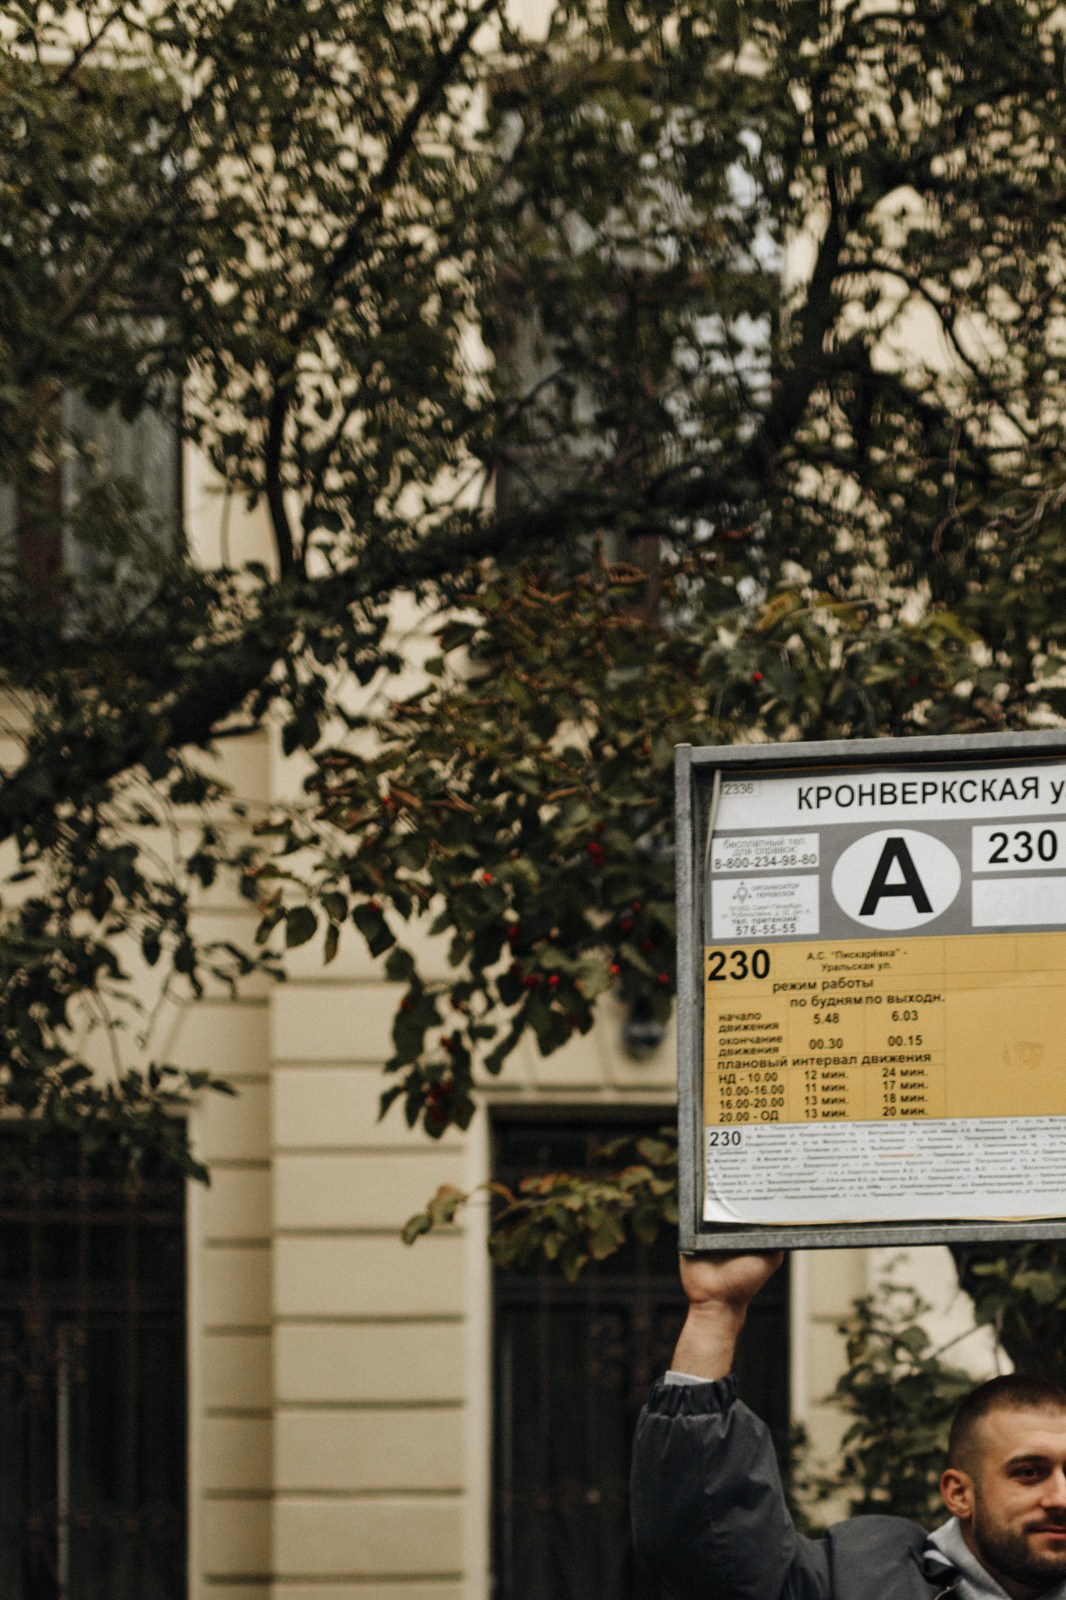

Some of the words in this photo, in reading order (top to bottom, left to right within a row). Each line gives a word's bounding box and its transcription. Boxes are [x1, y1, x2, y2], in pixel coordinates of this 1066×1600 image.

[798, 776, 1039, 810] КРОНВЕРКСКАЯ
[988, 829, 1058, 864] 230
[714, 854, 817, 869] 8-800-234-98-80
[736, 923, 796, 936] 576-55-55
[708, 949, 770, 981] 230
[821, 963, 875, 973] Уральская
[877, 963, 892, 971] ул.
[772, 981, 817, 994] режим
[822, 977, 874, 991] работы
[790, 998, 807, 1008] по
[811, 994, 863, 1009] будням
[865, 995, 882, 1006] по
[887, 993, 945, 1005] выходн.
[719, 1013, 761, 1022] начало
[813, 1013, 840, 1025] 5.48
[892, 1010, 919, 1022] 6.03
[718, 1022, 779, 1033] движения
[718, 1035, 783, 1046] окончание
[809, 1038, 843, 1050] 00.30
[888, 1035, 923, 1047] 00.15
[718, 1047, 779, 1058] движения
[718, 1056, 788, 1070] плановый
[792, 1055, 857, 1068] интервал
[861, 1053, 932, 1065] движения
[719, 1074, 737, 1085] НД
[748, 1072, 778, 1083] 10.00
[804, 1070, 818, 1080] 12
[821, 1070, 849, 1080] мин.
[882, 1068, 896, 1078] 24
[900, 1068, 928, 1077] мин.
[719, 1085, 784, 1097] 10.00-16.00
[805, 1083, 817, 1093] 11
[821, 1083, 849, 1093] мин.
[883, 1081, 896, 1090] 17
[900, 1081, 928, 1090] мин.
[719, 1098, 785, 1110] 16.00-20.00
[805, 1096, 818, 1105] 13
[821, 1096, 849, 1105] мин.
[883, 1094, 896, 1103] 18
[900, 1094, 928, 1103] мин.
[719, 1111, 750, 1122] 20.00
[761, 1111, 779, 1122] ОД
[805, 1109, 818, 1118] 13
[821, 1109, 849, 1118] мин.
[883, 1107, 896, 1116] 20
[900, 1107, 929, 1116] мин.
[709, 1131, 741, 1147] 230
